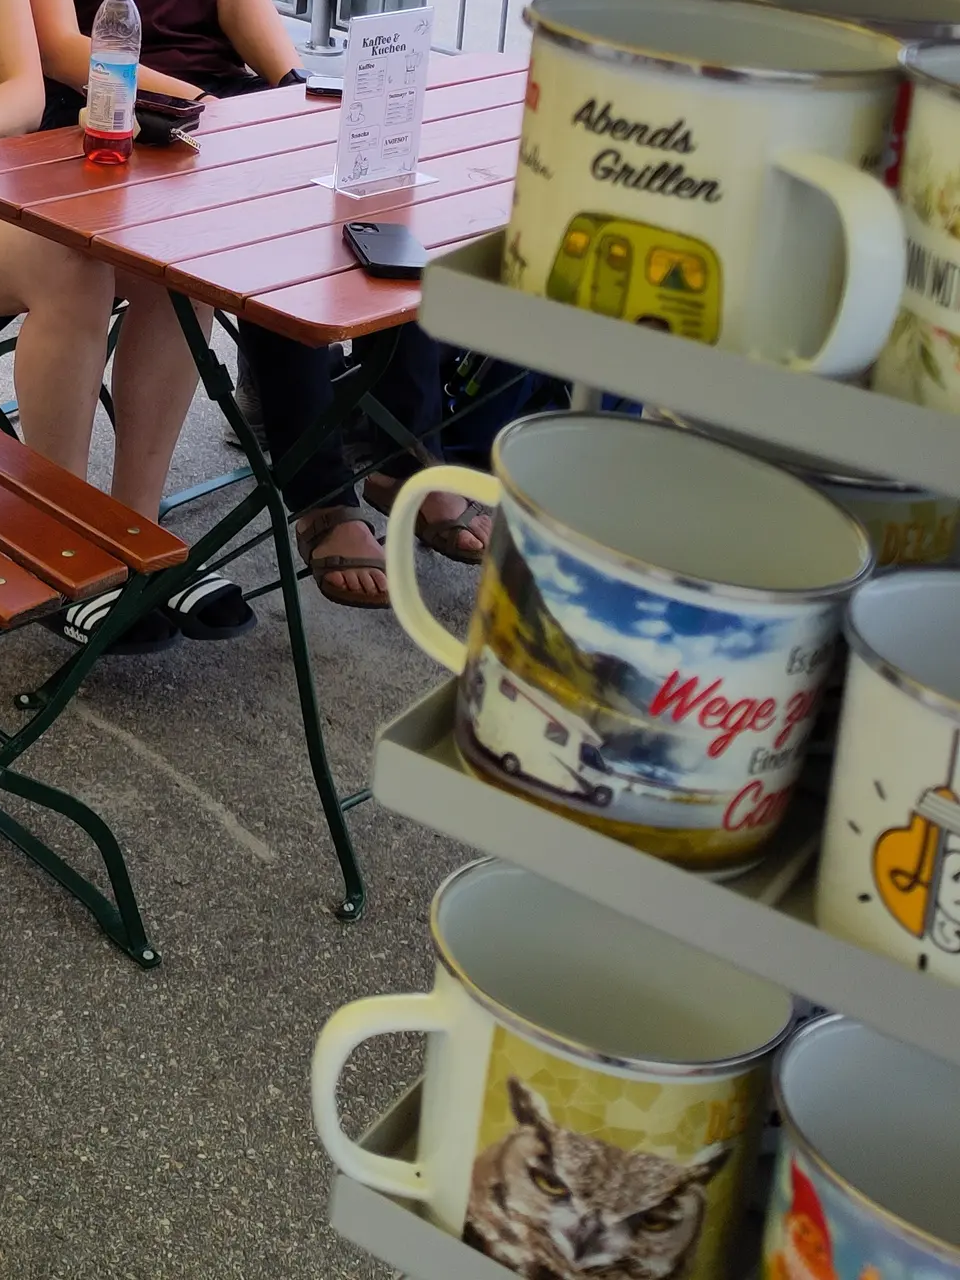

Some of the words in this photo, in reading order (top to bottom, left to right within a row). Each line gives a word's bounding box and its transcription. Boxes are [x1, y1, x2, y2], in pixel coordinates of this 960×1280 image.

[362, 35, 392, 49] Kaffee
[393, 32, 401, 43] &
[371, 43, 407, 57] Kuchen
[571, 96, 697, 155] Abends
[590, 147, 723, 203] Grillen
[649, 668, 777, 759] Wege
